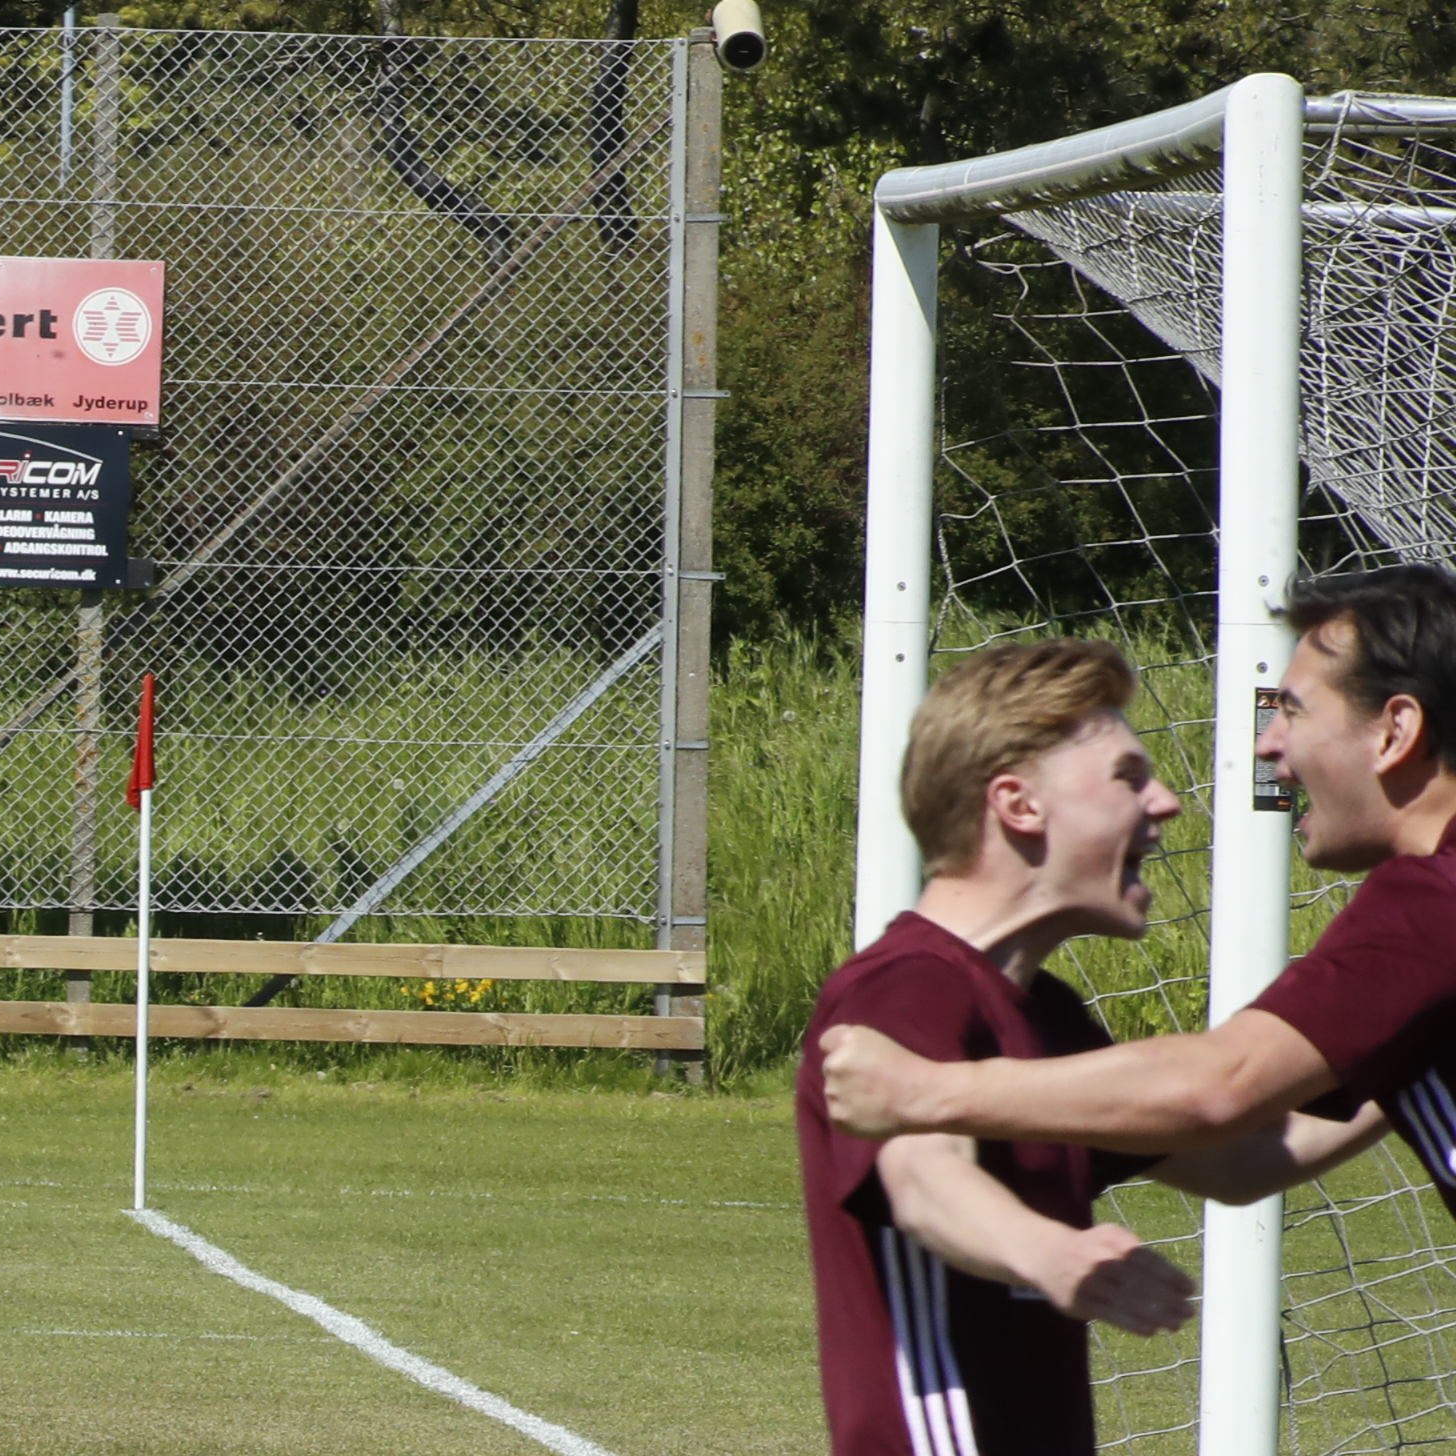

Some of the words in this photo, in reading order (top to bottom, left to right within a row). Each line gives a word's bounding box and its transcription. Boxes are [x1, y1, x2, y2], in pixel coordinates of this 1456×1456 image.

[73, 395, 148, 412] Jyderup
[77, 489, 99, 500] A/S
[44, 511, 93, 523] KAMERA
[4, 542, 108, 556] ADGANGSKONTROL
